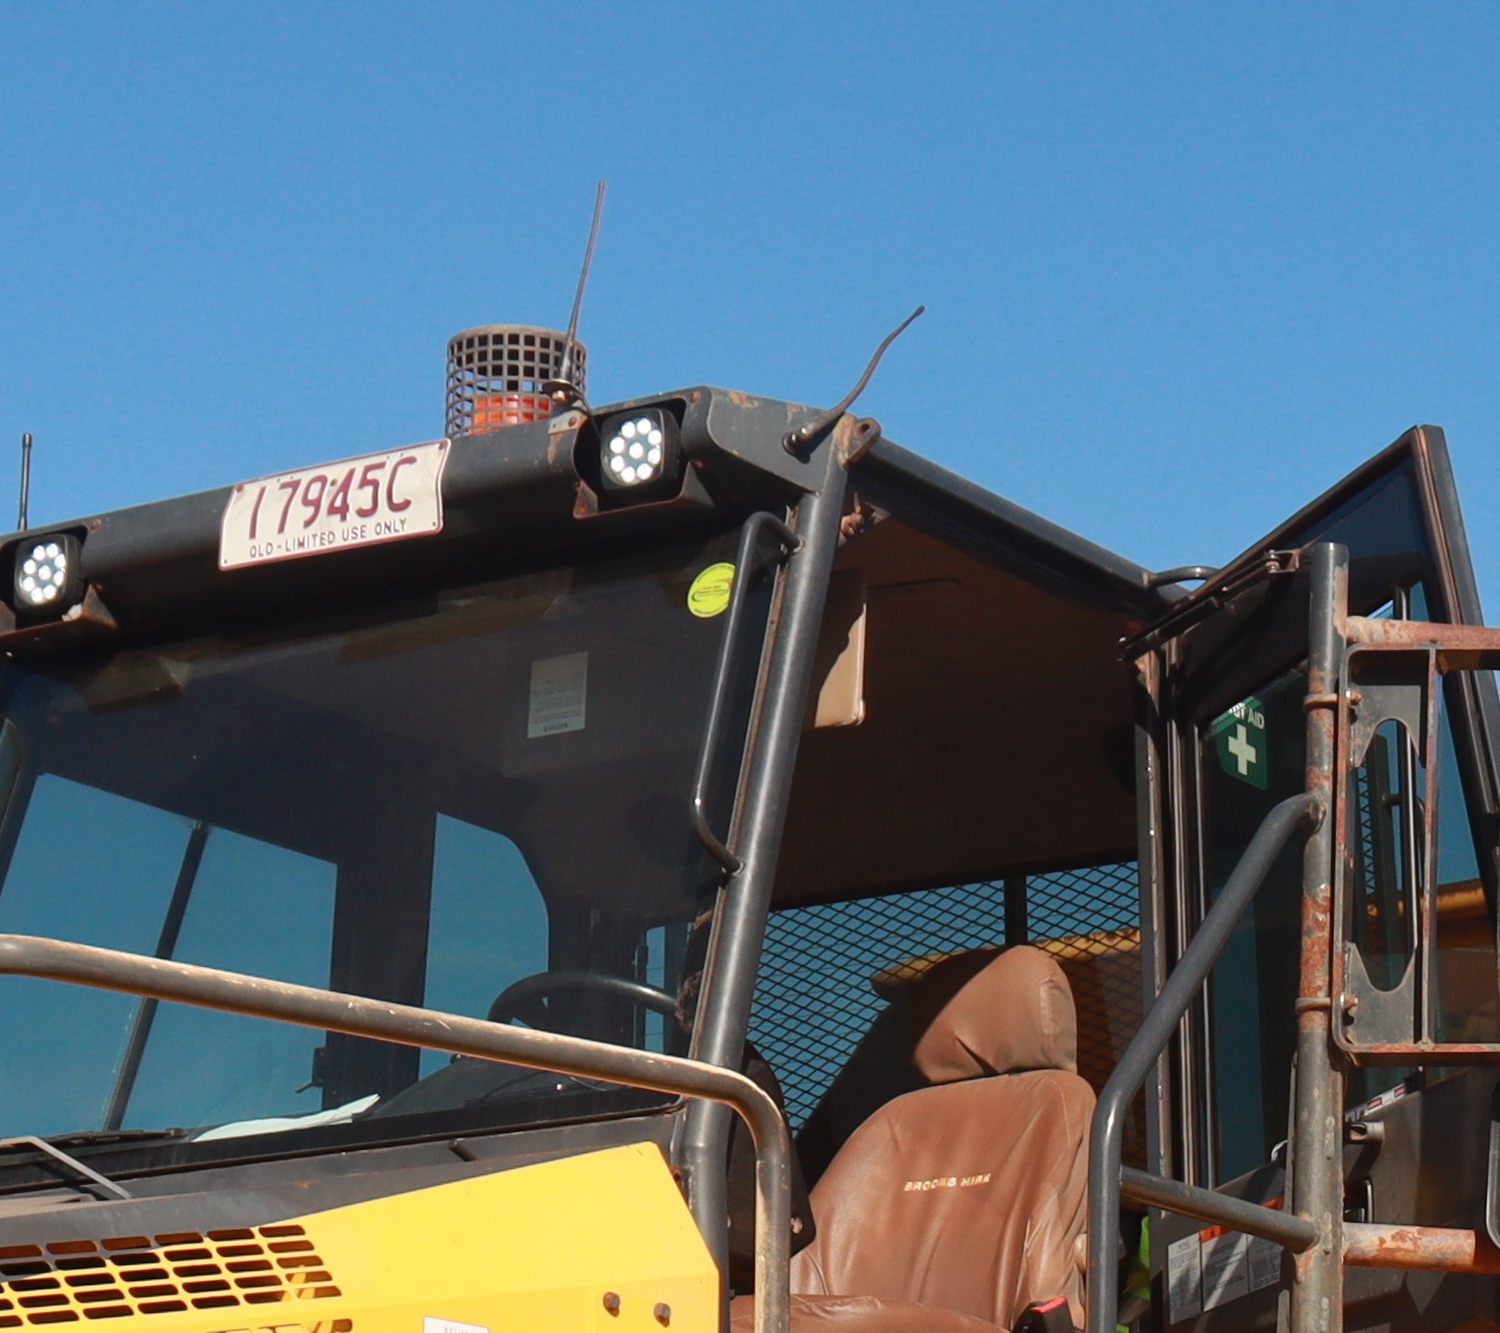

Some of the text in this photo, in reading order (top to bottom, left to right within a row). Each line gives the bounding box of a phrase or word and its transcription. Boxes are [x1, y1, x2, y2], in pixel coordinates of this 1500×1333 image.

[249, 456, 417, 540] 17945C
[342, 524, 367, 541] USE
[375, 517, 408, 537] ONLY
[1248, 708, 1266, 730] AID
[904, 1176, 957, 1192] BROOKS
